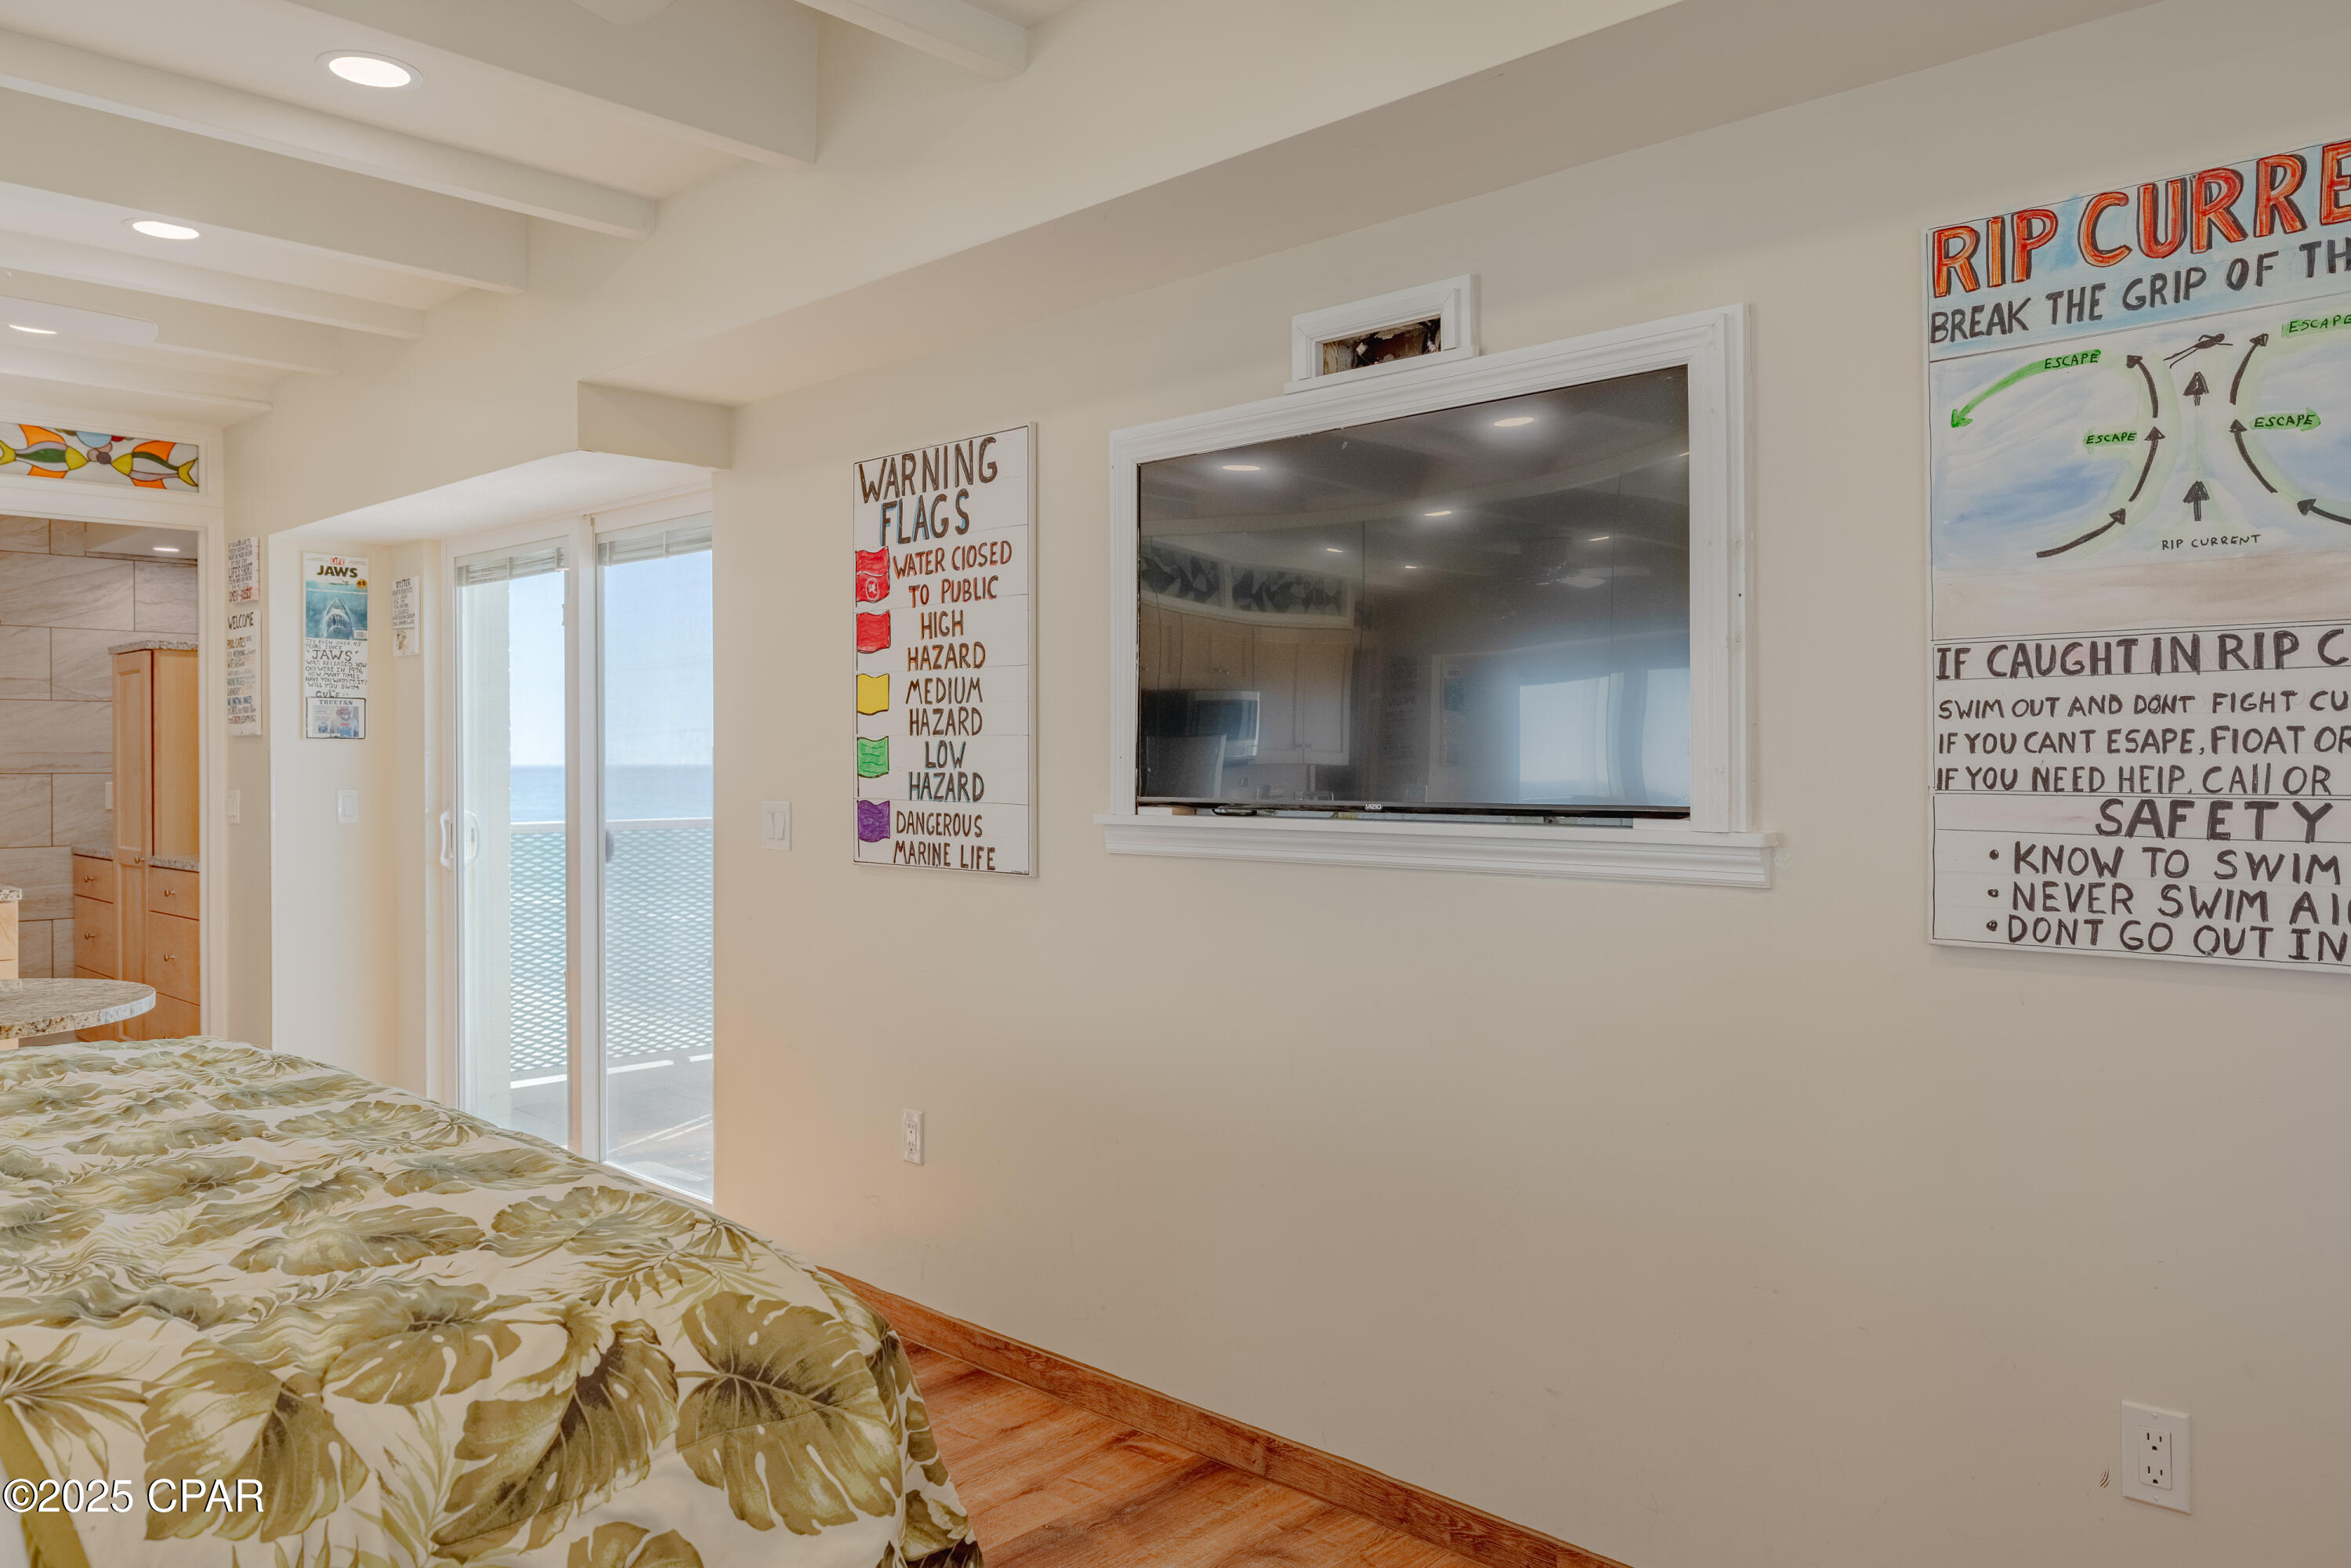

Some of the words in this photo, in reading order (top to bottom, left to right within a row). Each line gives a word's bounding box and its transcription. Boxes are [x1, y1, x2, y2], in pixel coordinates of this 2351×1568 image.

[1932, 208, 2059, 299] RIP
[2079, 140, 2351, 267] CURRE
[1930, 298, 2032, 344] BREAK
[2045, 282, 2106, 324] THE
[2122, 266, 2208, 311] GRIP
[2226, 251, 2280, 291] OF
[2299, 237, 2351, 278] TH
[2289, 314, 2351, 333] ESCAPE
[2044, 353, 2099, 369] ESCAPE
[2254, 415, 2316, 427] ESCAPE
[2085, 432, 2137, 444] ESCAPE
[858, 436, 998, 504] WARNING
[879, 488, 969, 547] FLAGS
[2162, 539, 2183, 550] RIP
[2191, 534, 2262, 548] CURRENT
[317, 565, 358, 578] JAWS
[892, 547, 946, 580] WATER
[908, 584, 930, 608] TO
[940, 574, 999, 604] PUBLIC
[227, 612, 254, 630] WELCOME
[920, 609, 964, 640] HIGH
[907, 641, 986, 672] HAZARD
[1936, 647, 1972, 680] IF
[1987, 638, 2139, 679] CAUGHT
[2151, 633, 2201, 676] IN
[2218, 630, 2300, 672] RIP
[906, 676, 983, 704] MEDIUM
[1938, 699, 2005, 720] SWIM
[2012, 697, 2061, 718] OUT
[2067, 694, 2123, 719] AND
[2133, 694, 2196, 715] DONT
[2212, 690, 2298, 713] FIGHT
[2309, 691, 2349, 712] CU
[909, 706, 983, 736] HAZARD
[924, 740, 966, 770] LOW
[1940, 732, 1958, 755] IF
[1965, 732, 2017, 755] YOU
[2024, 729, 2096, 754] CANT
[2313, 726, 2351, 754] OR
[908, 771, 984, 803] HAZARD
[1936, 767, 1958, 791] IF
[1965, 766, 2018, 791] YOU
[2032, 766, 2106, 793] NEED
[2283, 766, 2332, 796] OR
[896, 810, 983, 838] DANGEROUS
[2096, 798, 2334, 845] SAFETY
[893, 840, 951, 867] MARINE
[960, 844, 996, 871] LIFE
[2014, 841, 2124, 878] KNOW
[2142, 847, 2190, 878] TO
[2214, 849, 2341, 885] SWIM
[2012, 882, 2134, 915] NEVER
[2157, 884, 2269, 924] SWIM
[2008, 914, 2104, 946] DONT
[2119, 920, 2174, 952] GO
[2193, 925, 2275, 958] OUT
[2288, 928, 2348, 962] IN
